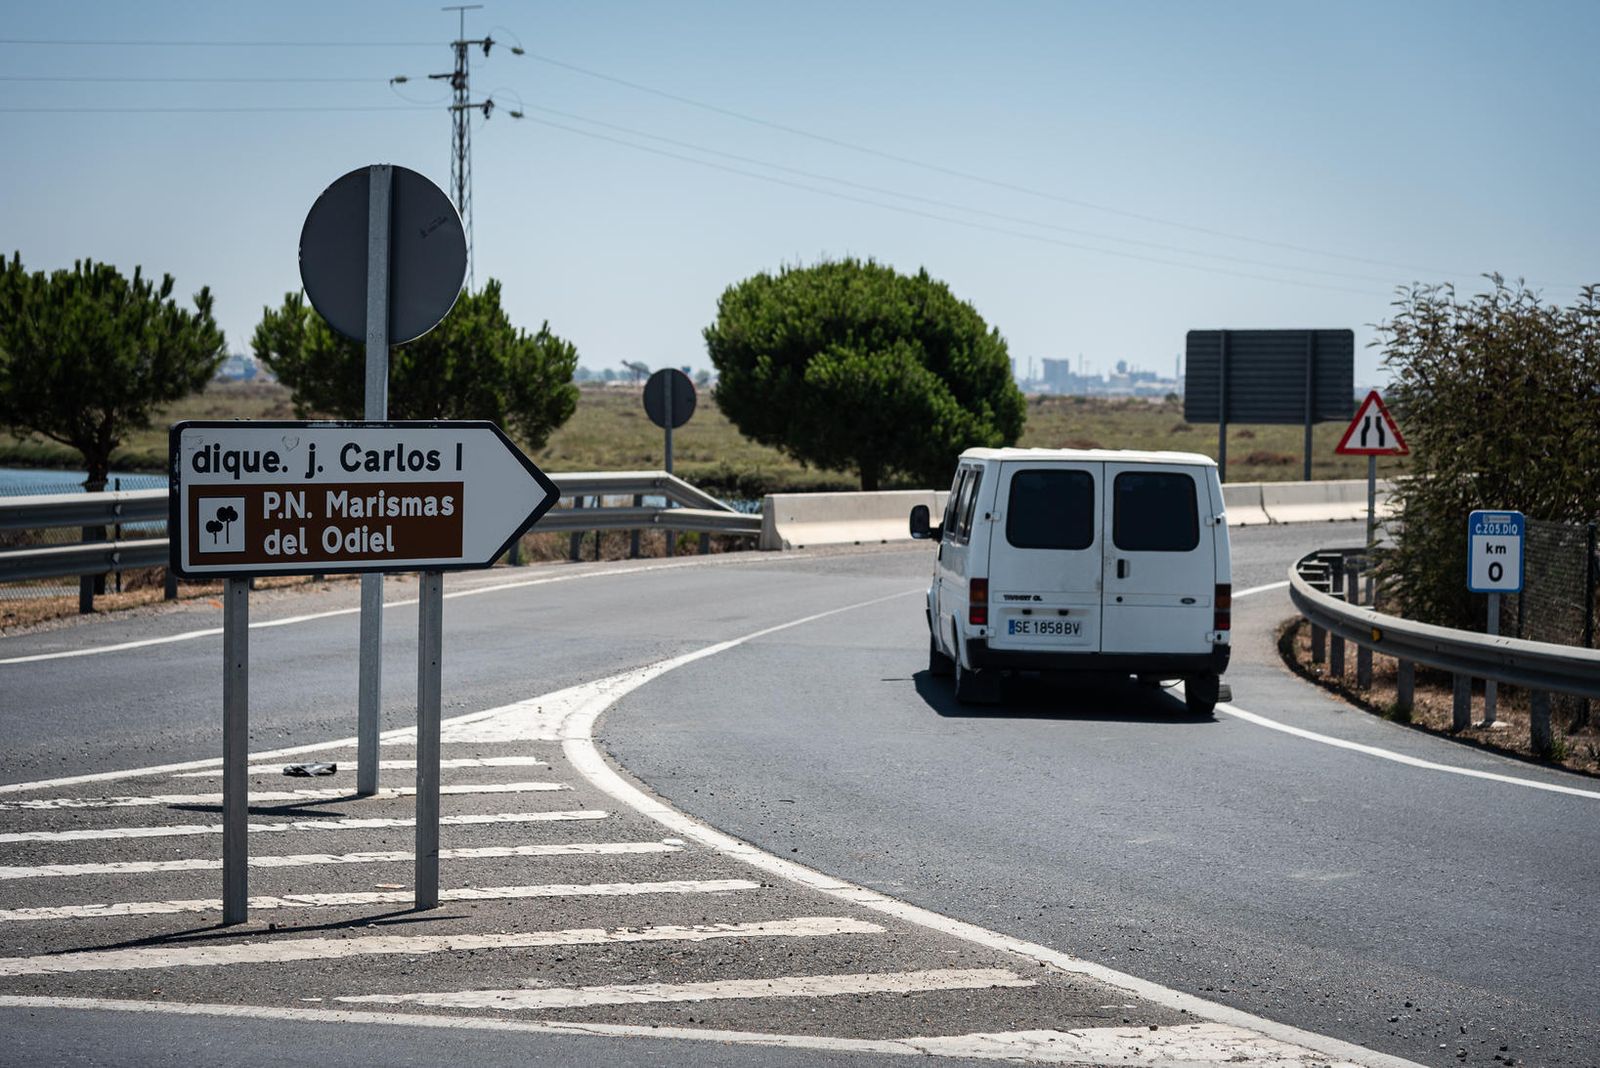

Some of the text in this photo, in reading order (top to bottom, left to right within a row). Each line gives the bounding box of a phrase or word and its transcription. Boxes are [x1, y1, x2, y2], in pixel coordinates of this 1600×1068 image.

[192, 443, 288, 480] dique.
[305, 443, 324, 479] j.
[339, 442, 441, 473] Carlos
[263, 489, 455, 520] P.N. Marismas
[263, 525, 395, 556] del Odiel
[1486, 542, 1507, 554] km
[1488, 561, 1504, 582] 0
[1015, 621, 1031, 633] SE
